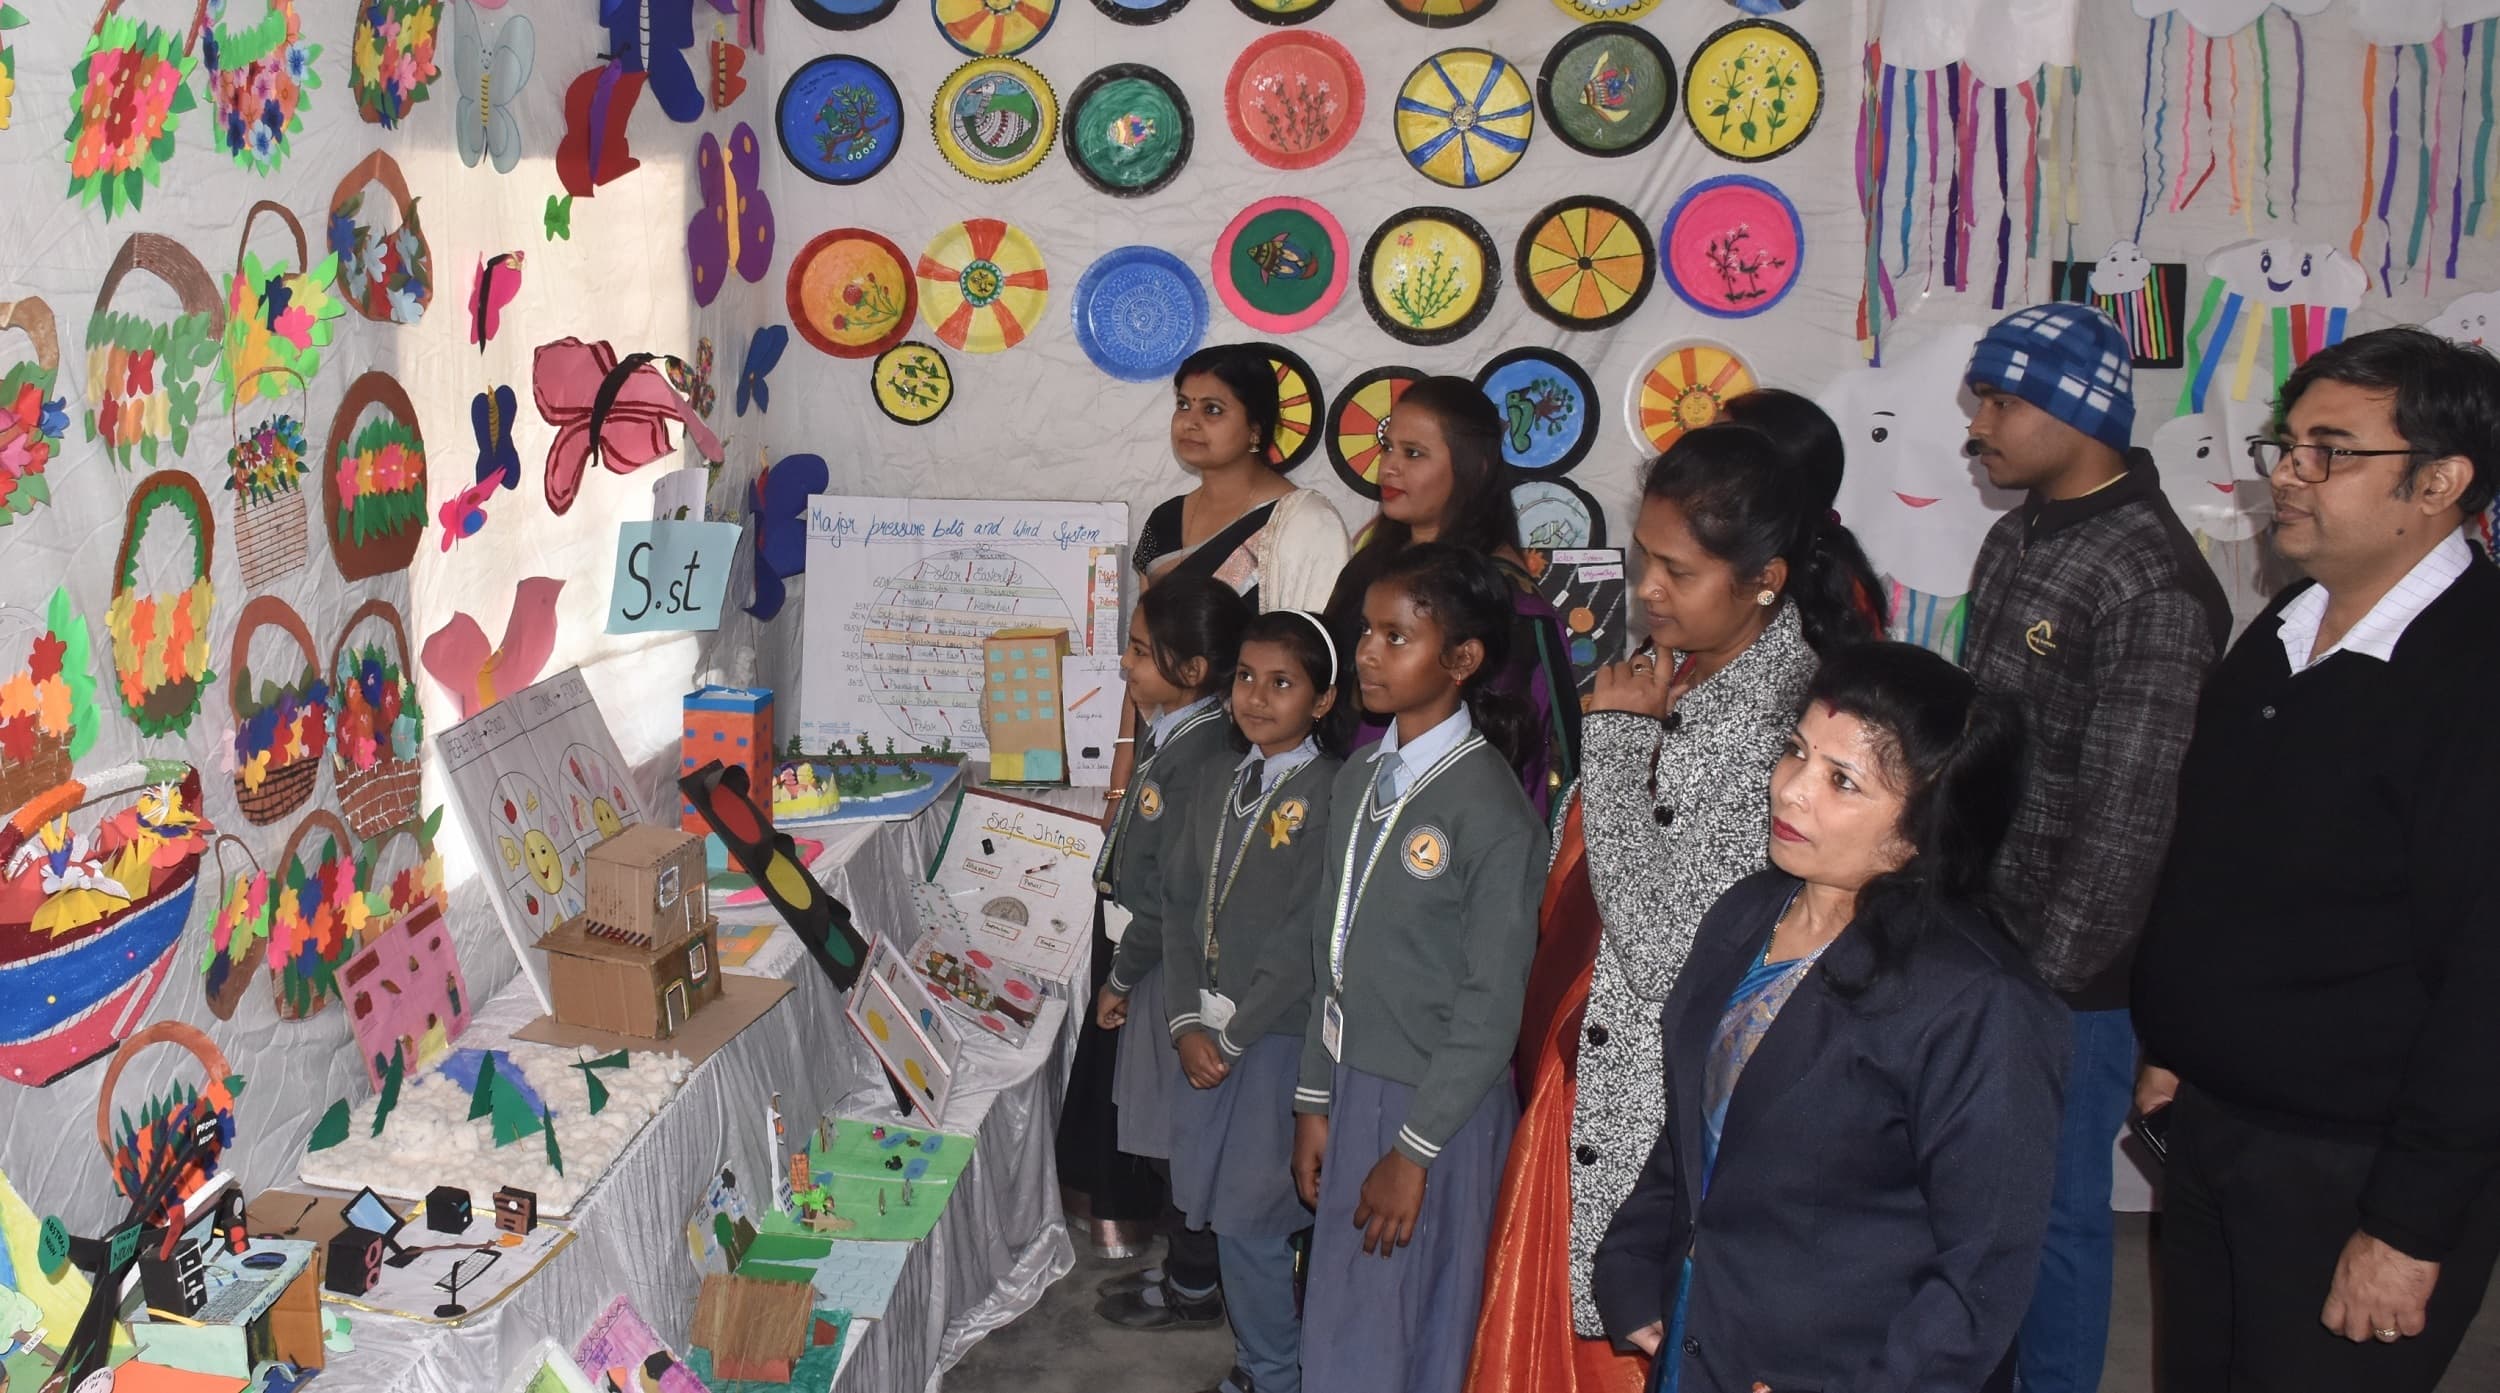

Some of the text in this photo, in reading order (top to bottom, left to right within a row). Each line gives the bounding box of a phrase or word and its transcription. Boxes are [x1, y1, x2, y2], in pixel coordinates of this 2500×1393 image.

[811, 510, 856, 548] Major
[974, 516, 1002, 535] and
[622, 541, 702, 621] S.st
[922, 562, 962, 583] Polar
[986, 811, 1025, 840] Safe
[1342, 822, 1362, 893] INTERNATIONAL
[1355, 830, 1388, 898] INTERNATIONAL
[1337, 894, 1348, 926] VISION
